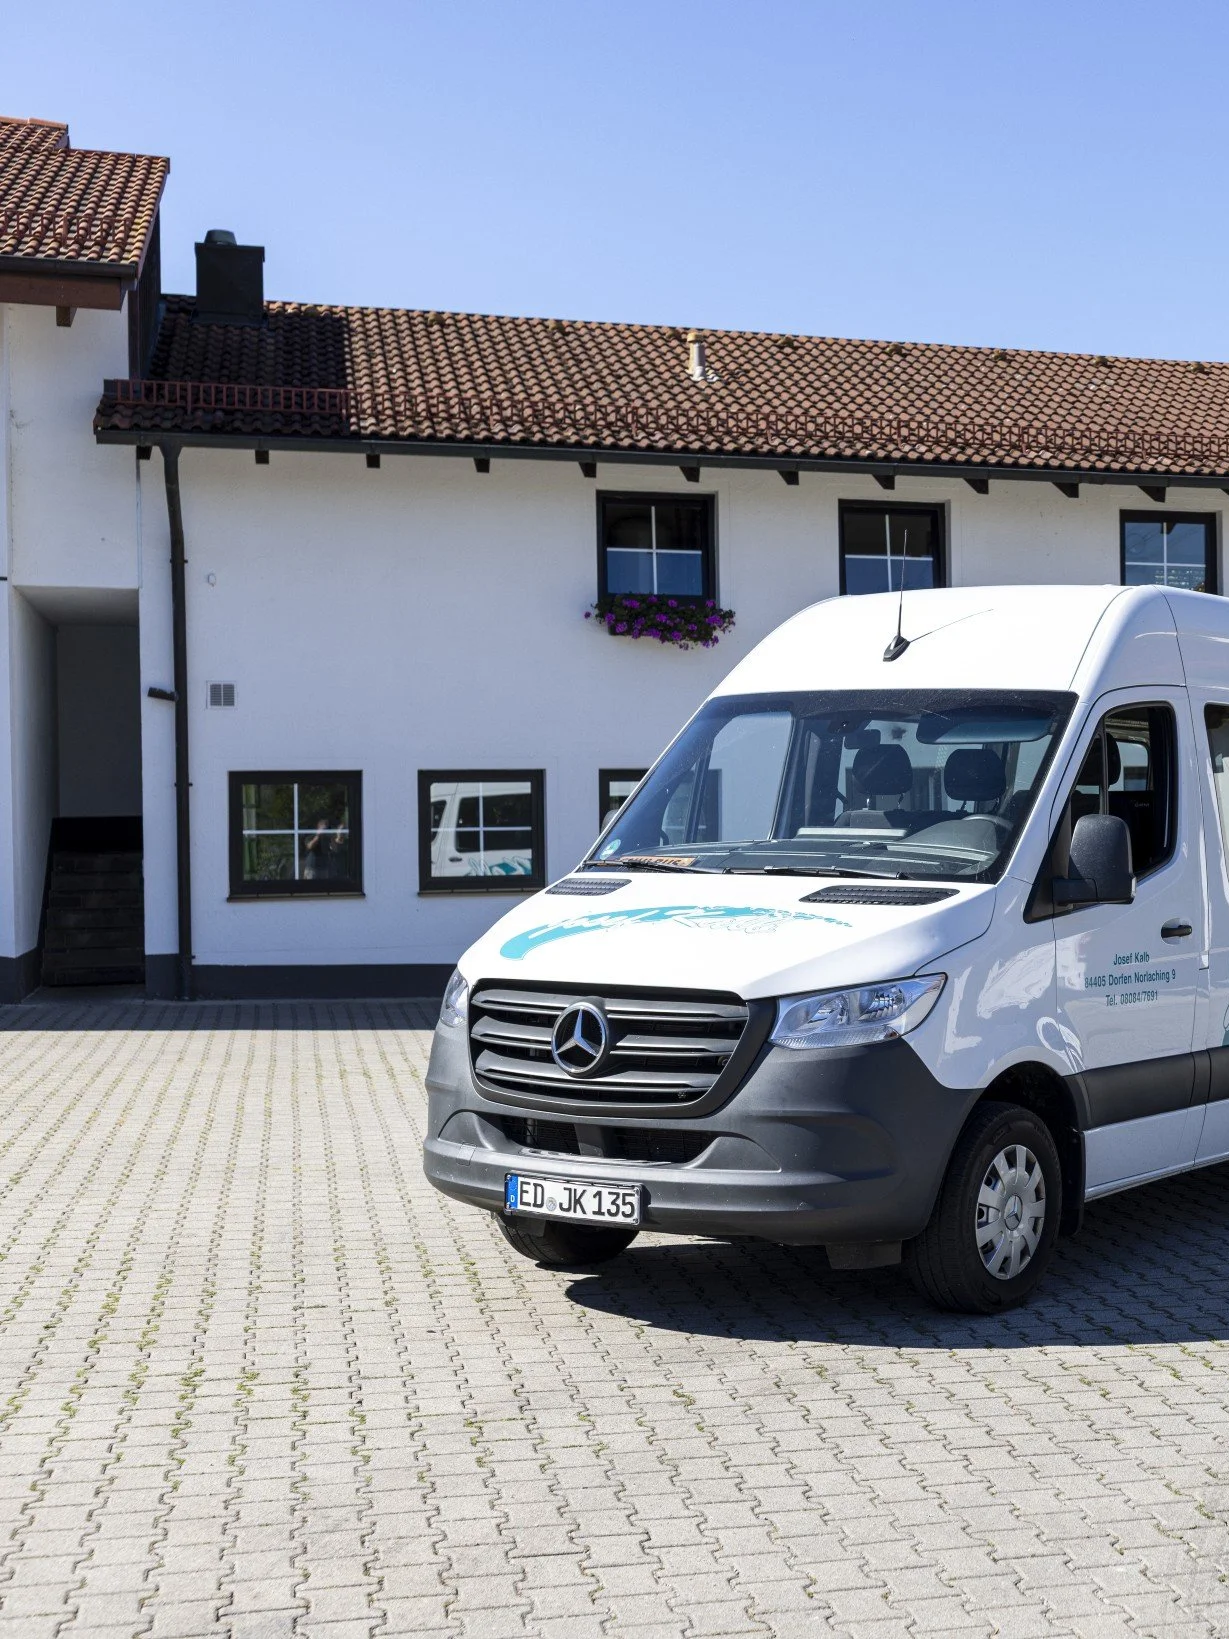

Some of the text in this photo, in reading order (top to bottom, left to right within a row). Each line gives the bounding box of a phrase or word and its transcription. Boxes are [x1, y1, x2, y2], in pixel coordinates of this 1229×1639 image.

[1113, 952, 1150, 965] Josef Kalb
[1084, 969, 1176, 988] 84405 Dorfen Norlaching 9
[1105, 990, 1158, 1006] Tel. 08084/7691
[519, 1180, 545, 1209] ED
[558, 1187, 587, 1215] JK
[591, 1190, 636, 1219] 135
